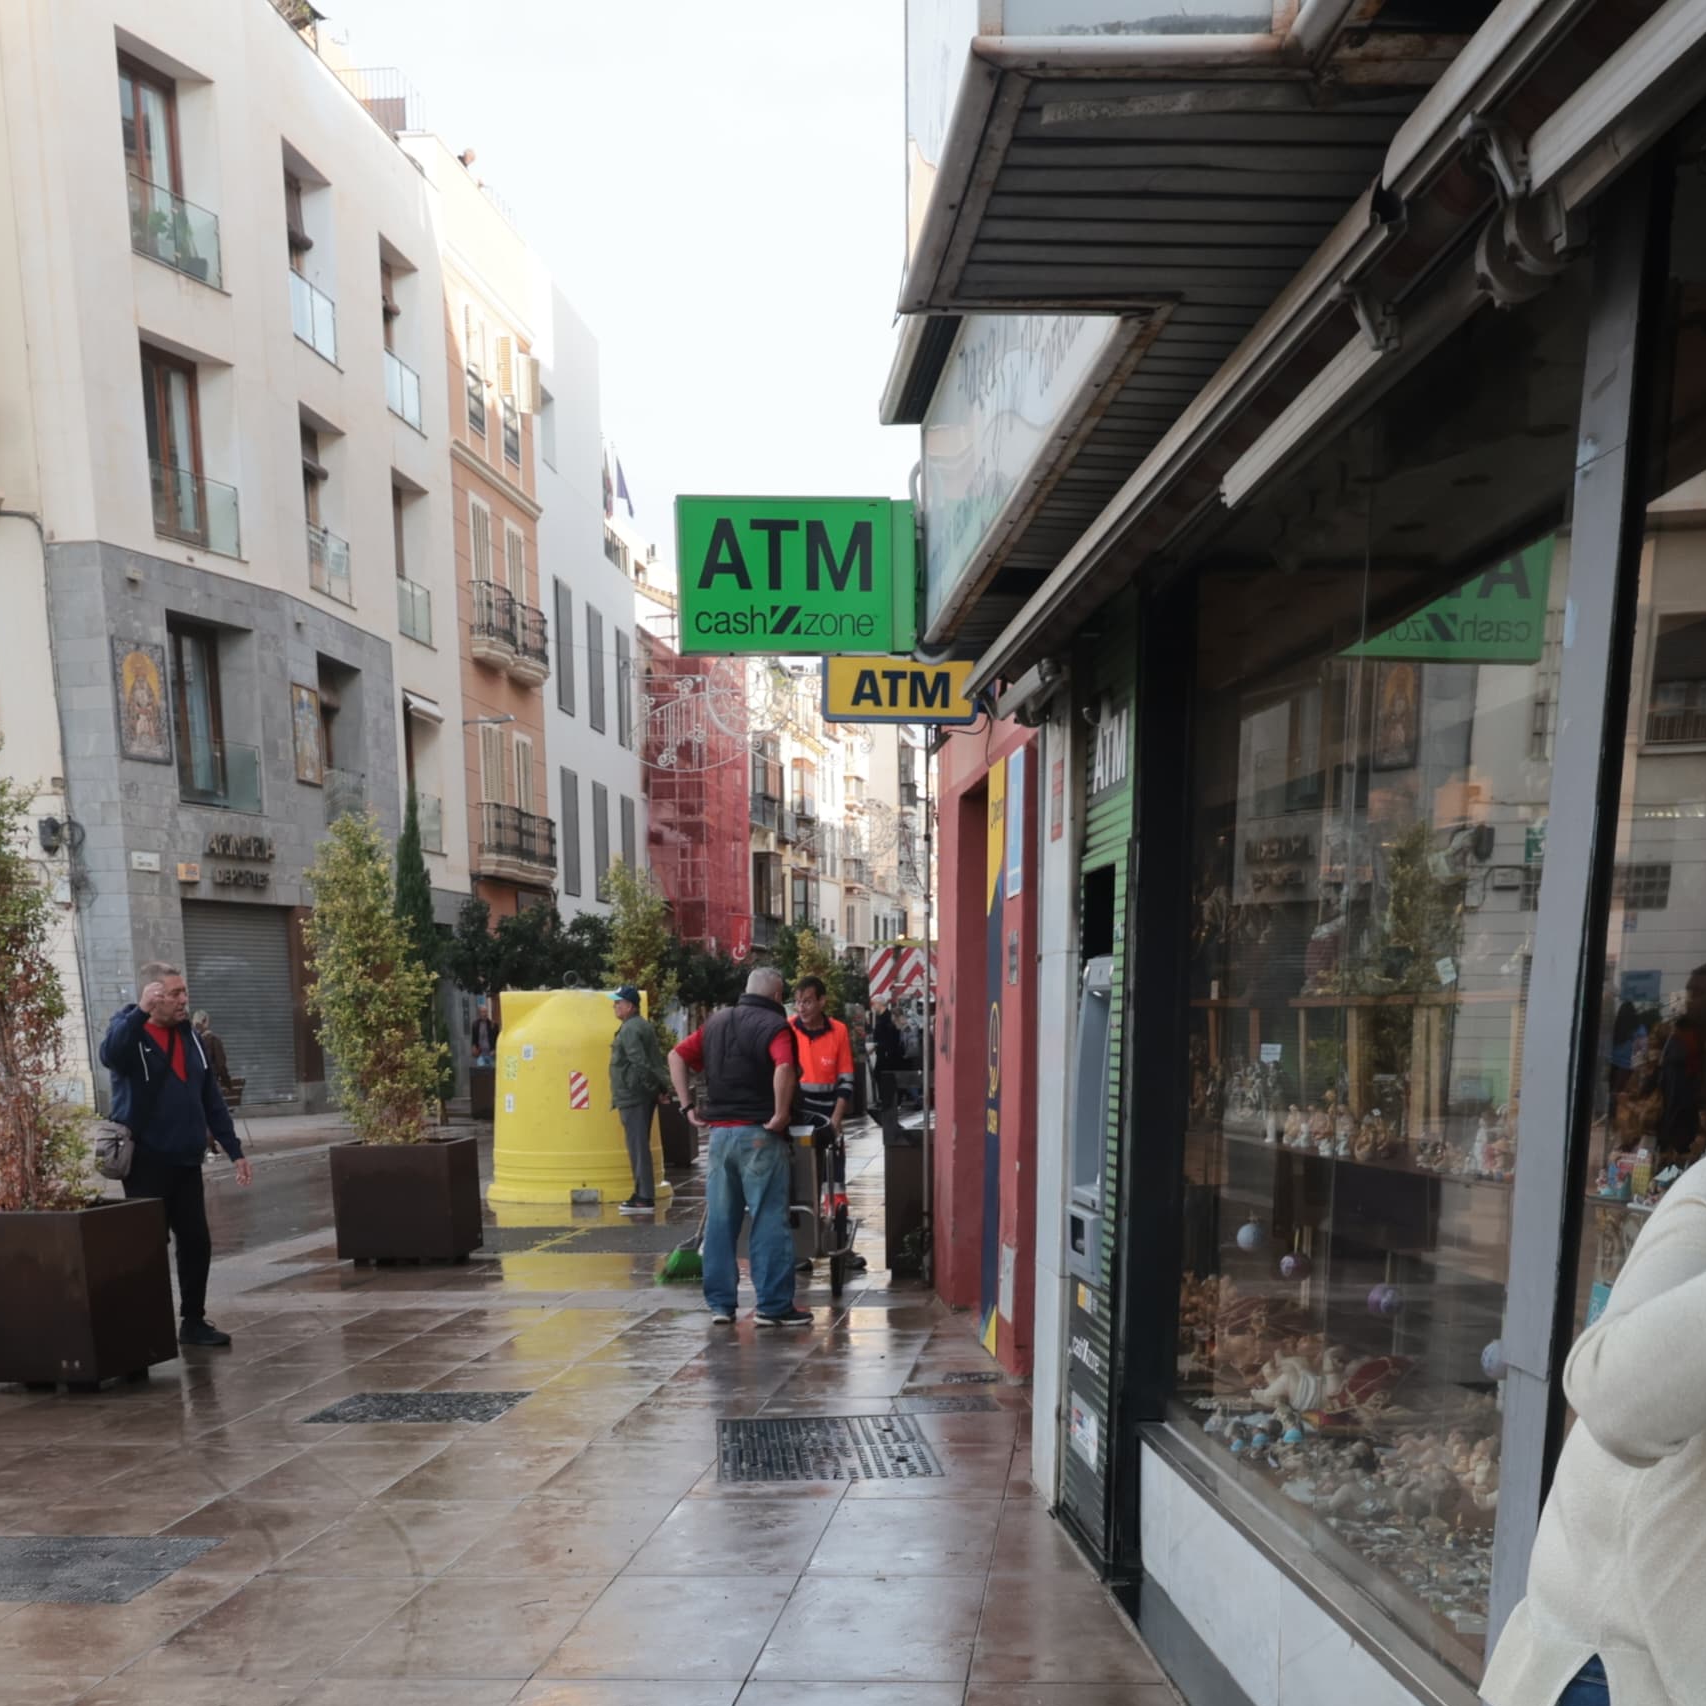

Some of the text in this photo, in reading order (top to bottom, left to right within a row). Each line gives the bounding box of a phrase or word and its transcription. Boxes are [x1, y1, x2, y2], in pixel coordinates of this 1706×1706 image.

[697, 518, 873, 592] ATM
[850, 669, 950, 709] ATM
[1093, 707, 1128, 794] ATM
